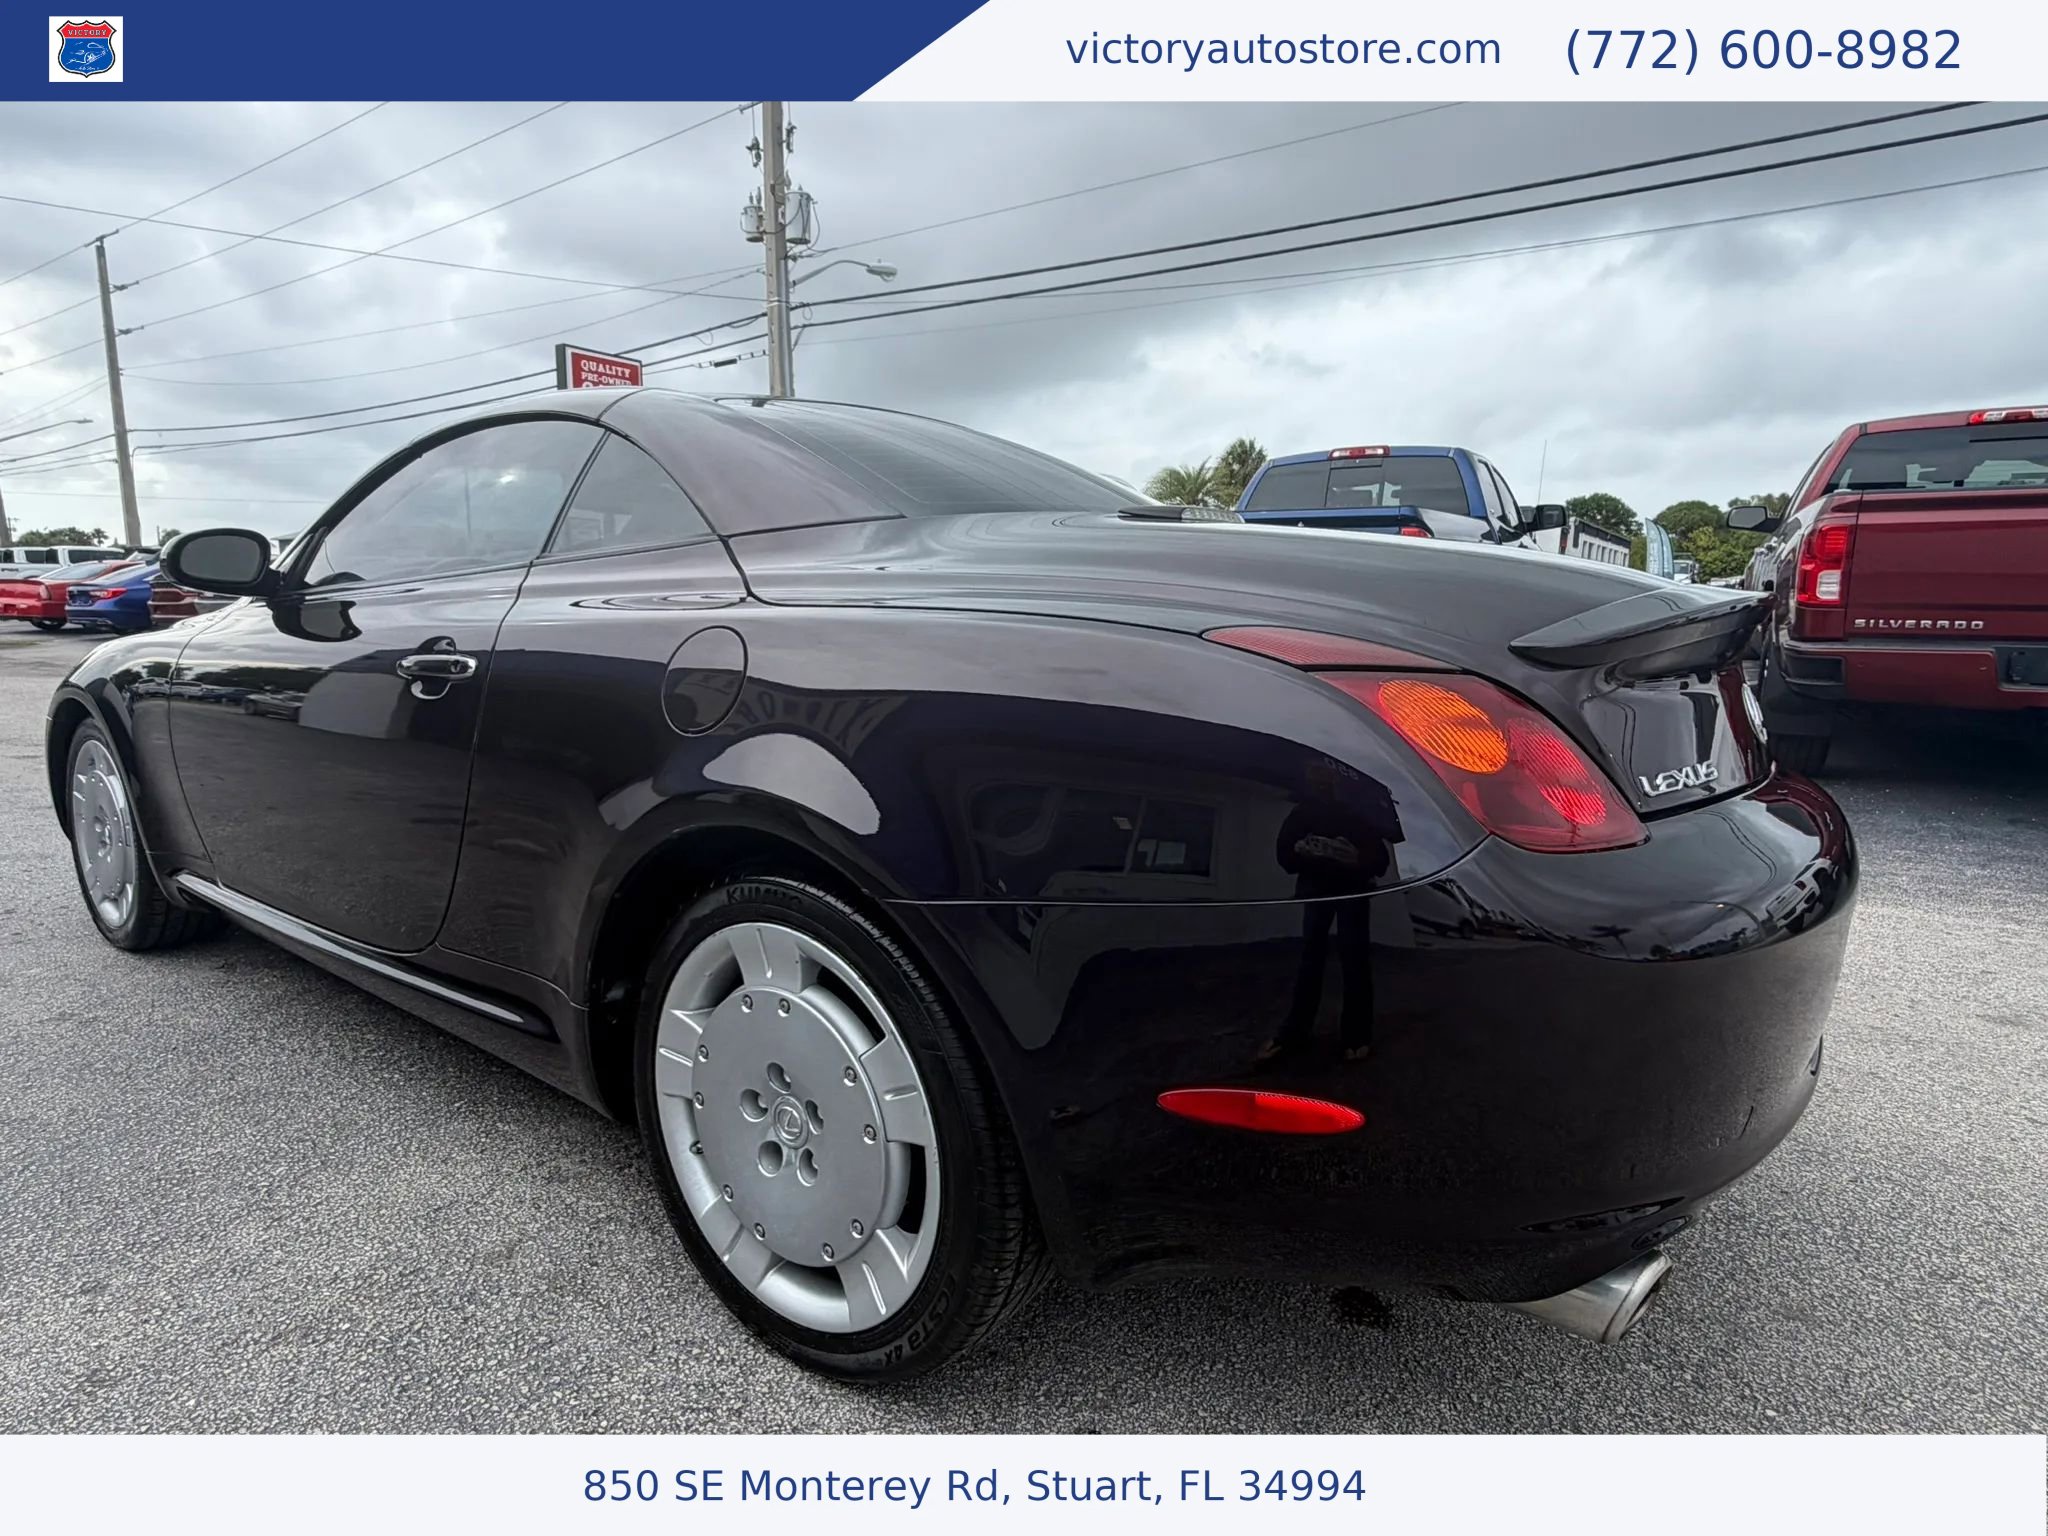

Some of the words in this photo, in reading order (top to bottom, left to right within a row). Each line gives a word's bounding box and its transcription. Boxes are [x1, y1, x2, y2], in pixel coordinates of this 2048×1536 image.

[581, 360, 631, 378] QUALITY
[1854, 619, 1984, 630] SILVERADO
[1638, 760, 1720, 797] LEXUS
